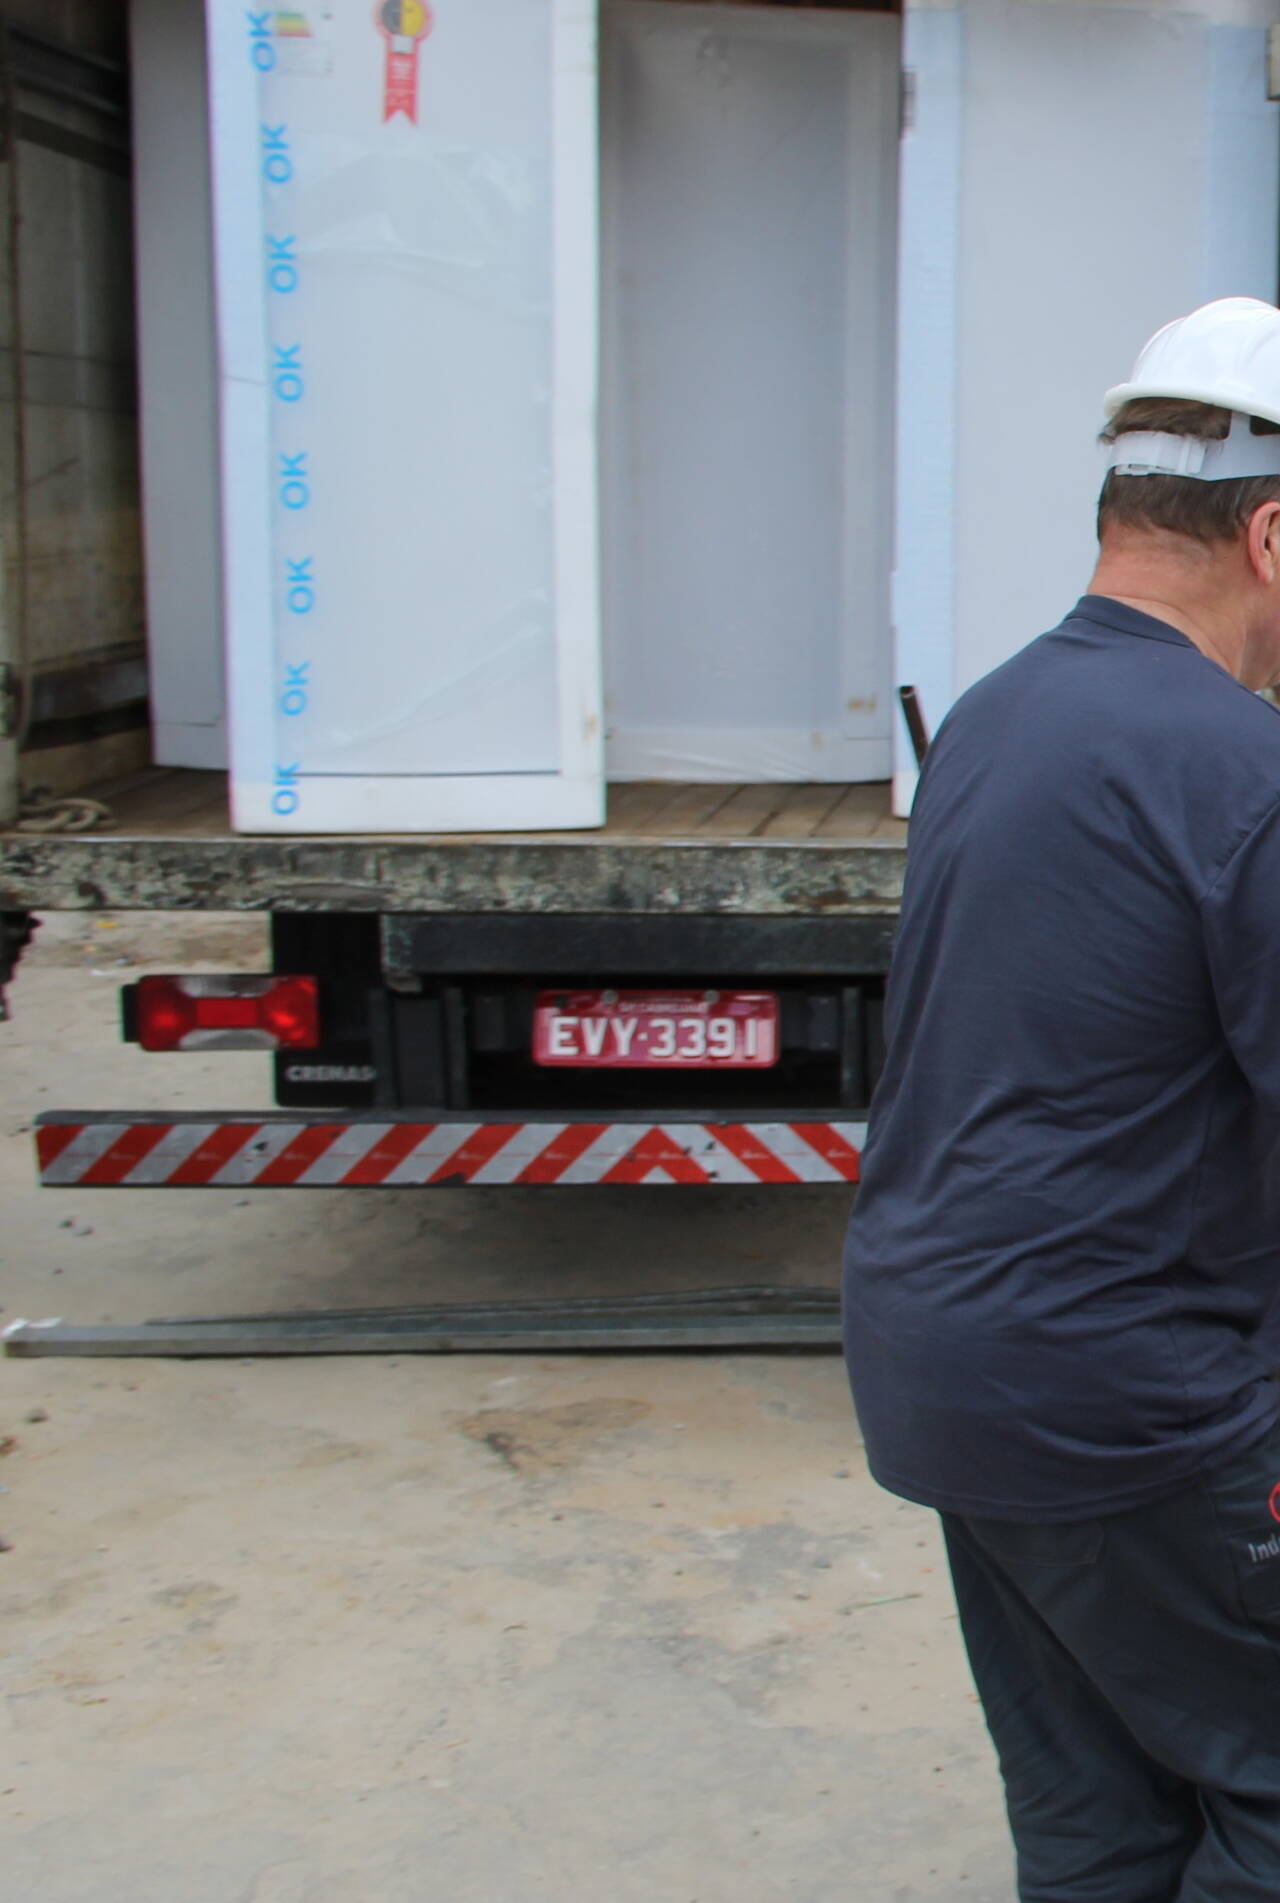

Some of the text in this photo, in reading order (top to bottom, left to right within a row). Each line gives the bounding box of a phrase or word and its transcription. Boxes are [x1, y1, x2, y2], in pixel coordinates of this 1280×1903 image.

[245, 10, 316, 817] OK OK OK OK OK OK OK OK
